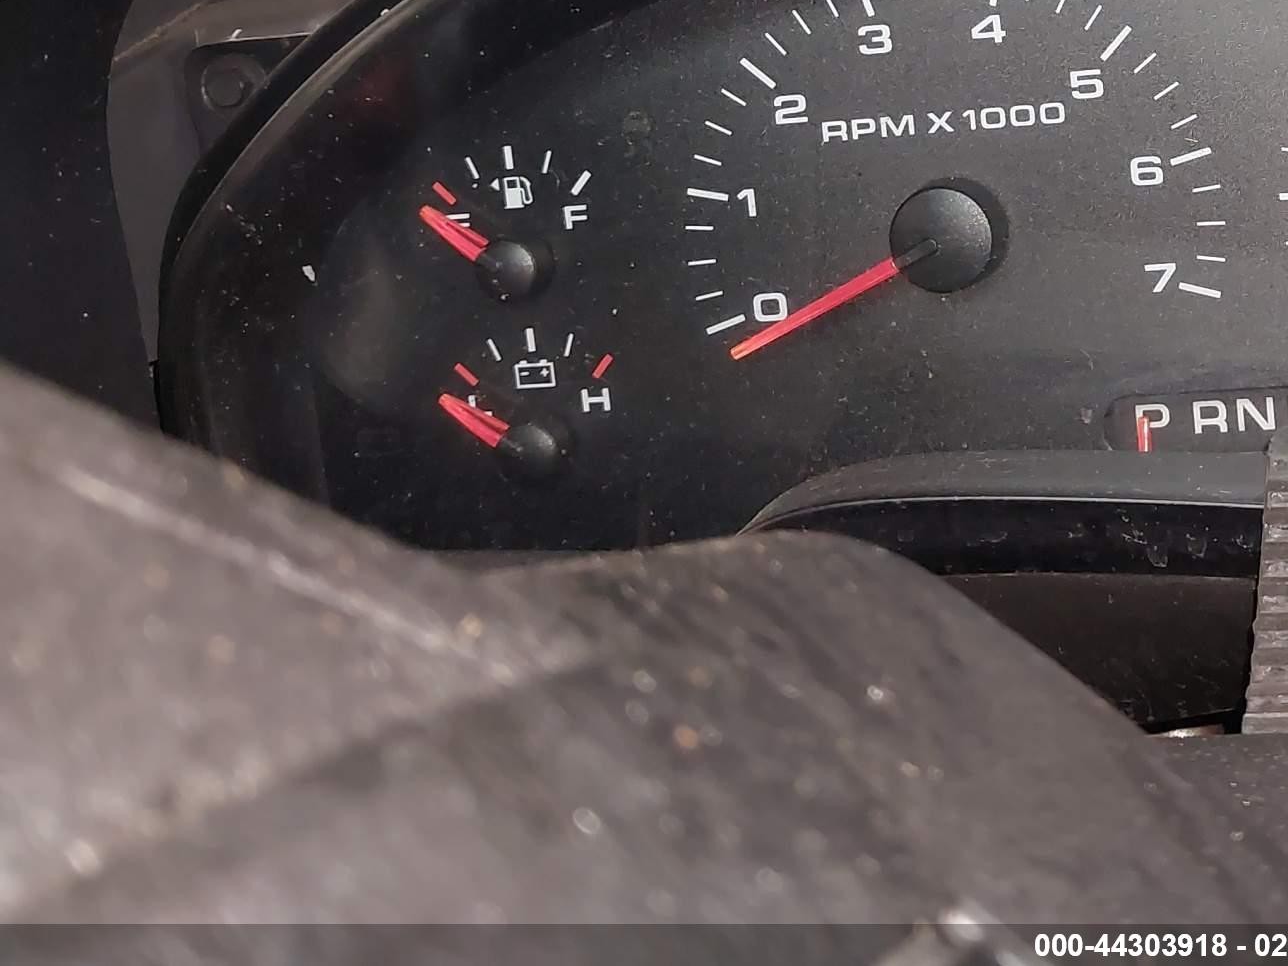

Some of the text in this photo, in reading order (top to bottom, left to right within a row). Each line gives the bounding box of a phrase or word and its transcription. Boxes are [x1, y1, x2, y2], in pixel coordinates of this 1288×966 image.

[858, 25, 892, 54] 3
[972, 15, 1006, 43] 4
[1070, 69, 1103, 99] 5
[774, 95, 808, 124] 2
[822, 103, 1065, 143] RPM X 1000
[1131, 156, 1163, 185] 6
[563, 205, 587, 229] F
[737, 189, 756, 216] 1
[1145, 263, 1176, 292] 7
[753, 293, 787, 321] 0
[581, 388, 610, 412] H
